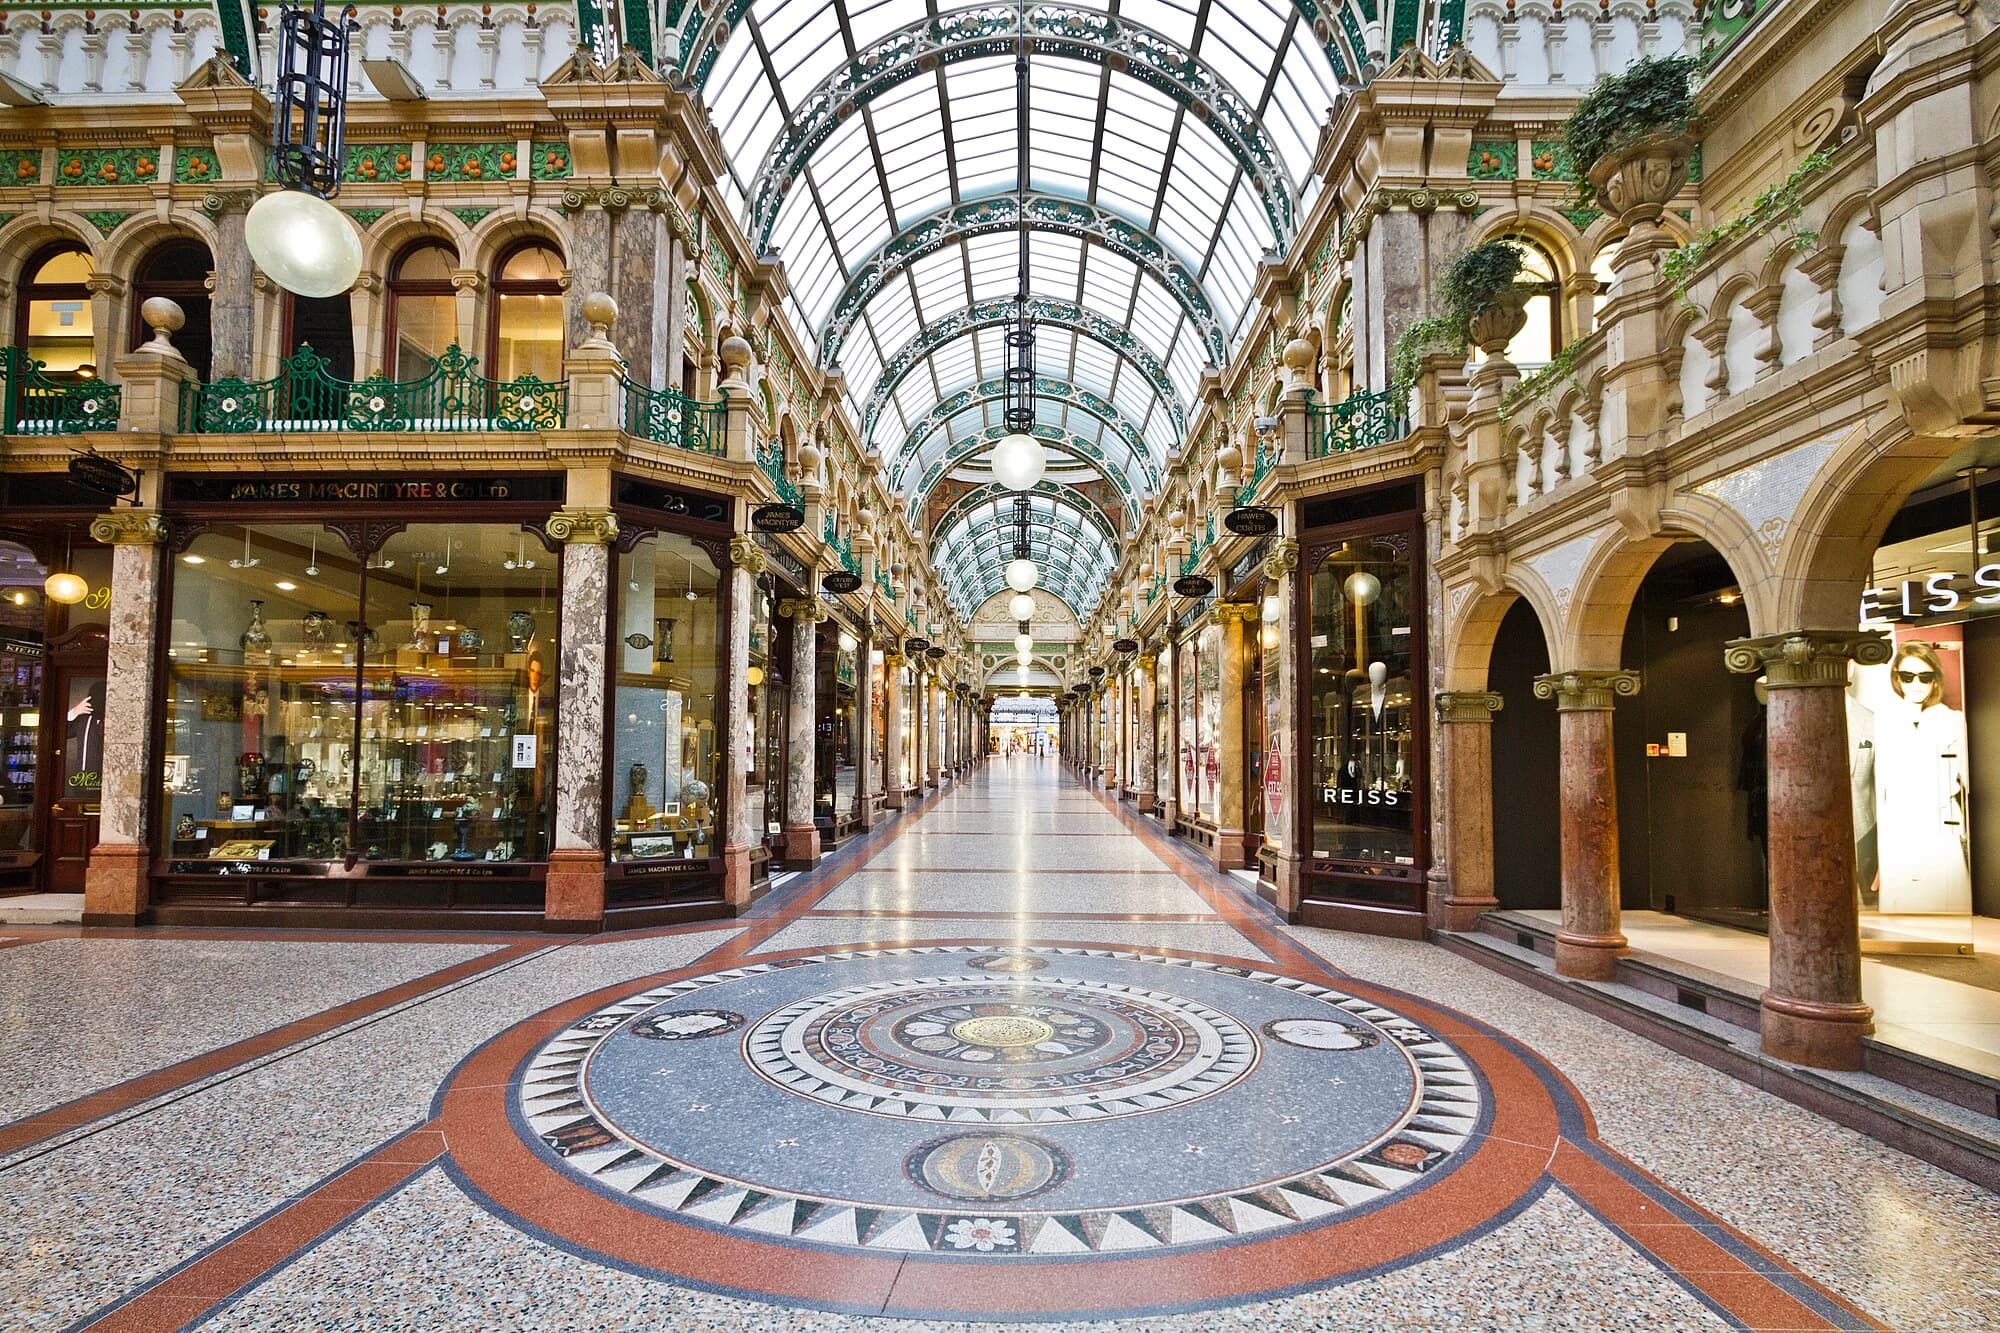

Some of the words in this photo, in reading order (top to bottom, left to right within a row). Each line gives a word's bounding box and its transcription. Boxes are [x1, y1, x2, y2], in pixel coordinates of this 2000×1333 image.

[231, 482, 301, 500] JAMES
[308, 482, 432, 499] MACINTYRE
[434, 482, 447, 498] &
[663, 494, 685, 510] 23
[756, 519, 799, 527] MACINTYRE
[765, 511, 791, 519] JAMES
[1323, 788, 1399, 806] REISS
